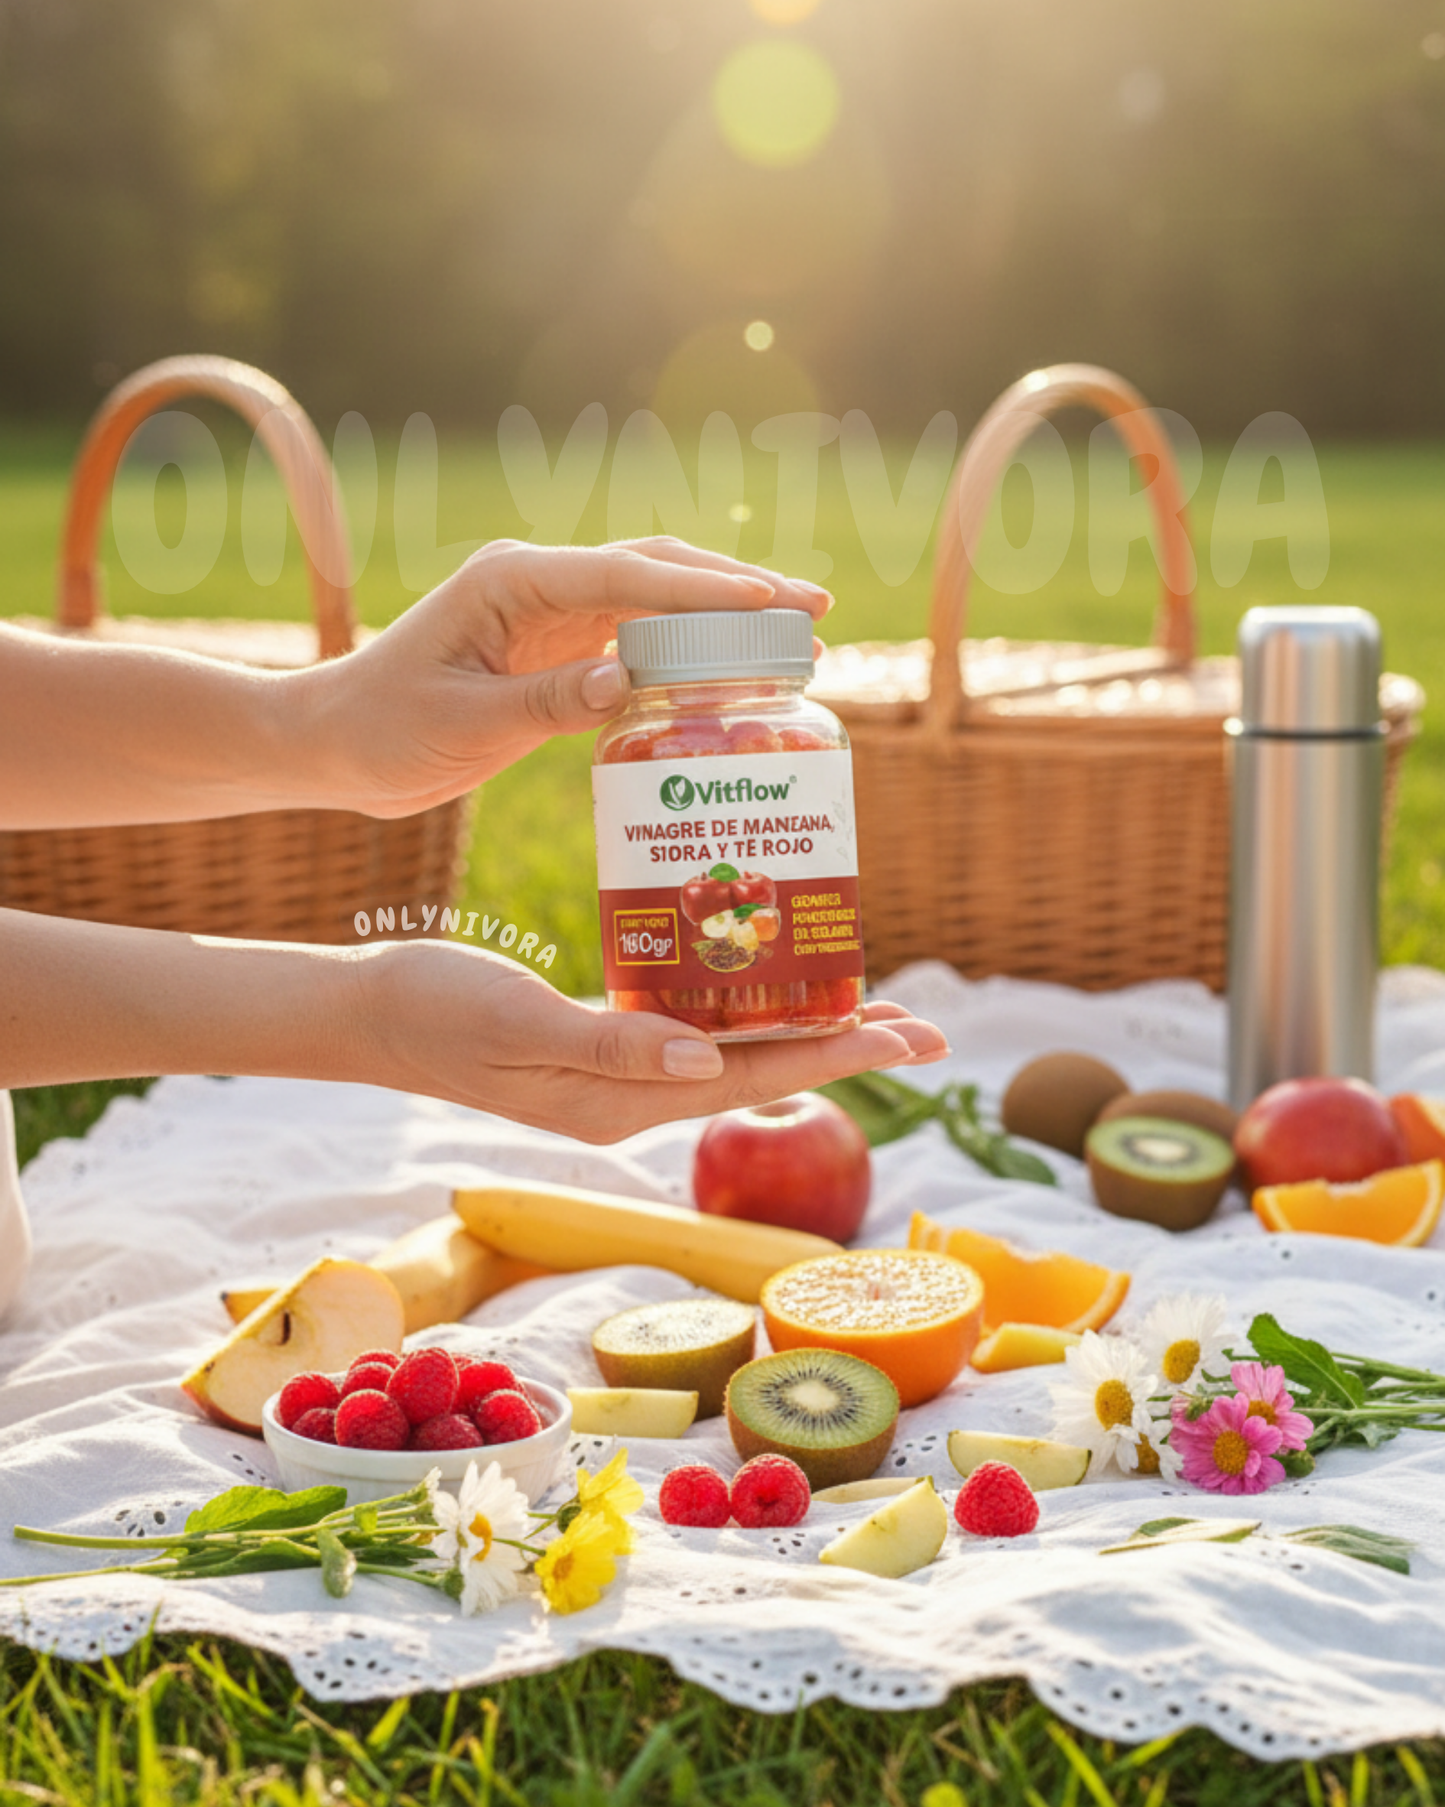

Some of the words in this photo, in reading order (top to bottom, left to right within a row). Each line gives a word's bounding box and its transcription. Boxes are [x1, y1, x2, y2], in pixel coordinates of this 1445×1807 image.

[694, 777, 790, 805] Vitflow
[624, 820, 706, 842] VINAGRE
[711, 819, 738, 837] DE
[717, 842, 729, 859] Y
[734, 839, 757, 859] TE
[762, 837, 814, 857] ROJO
